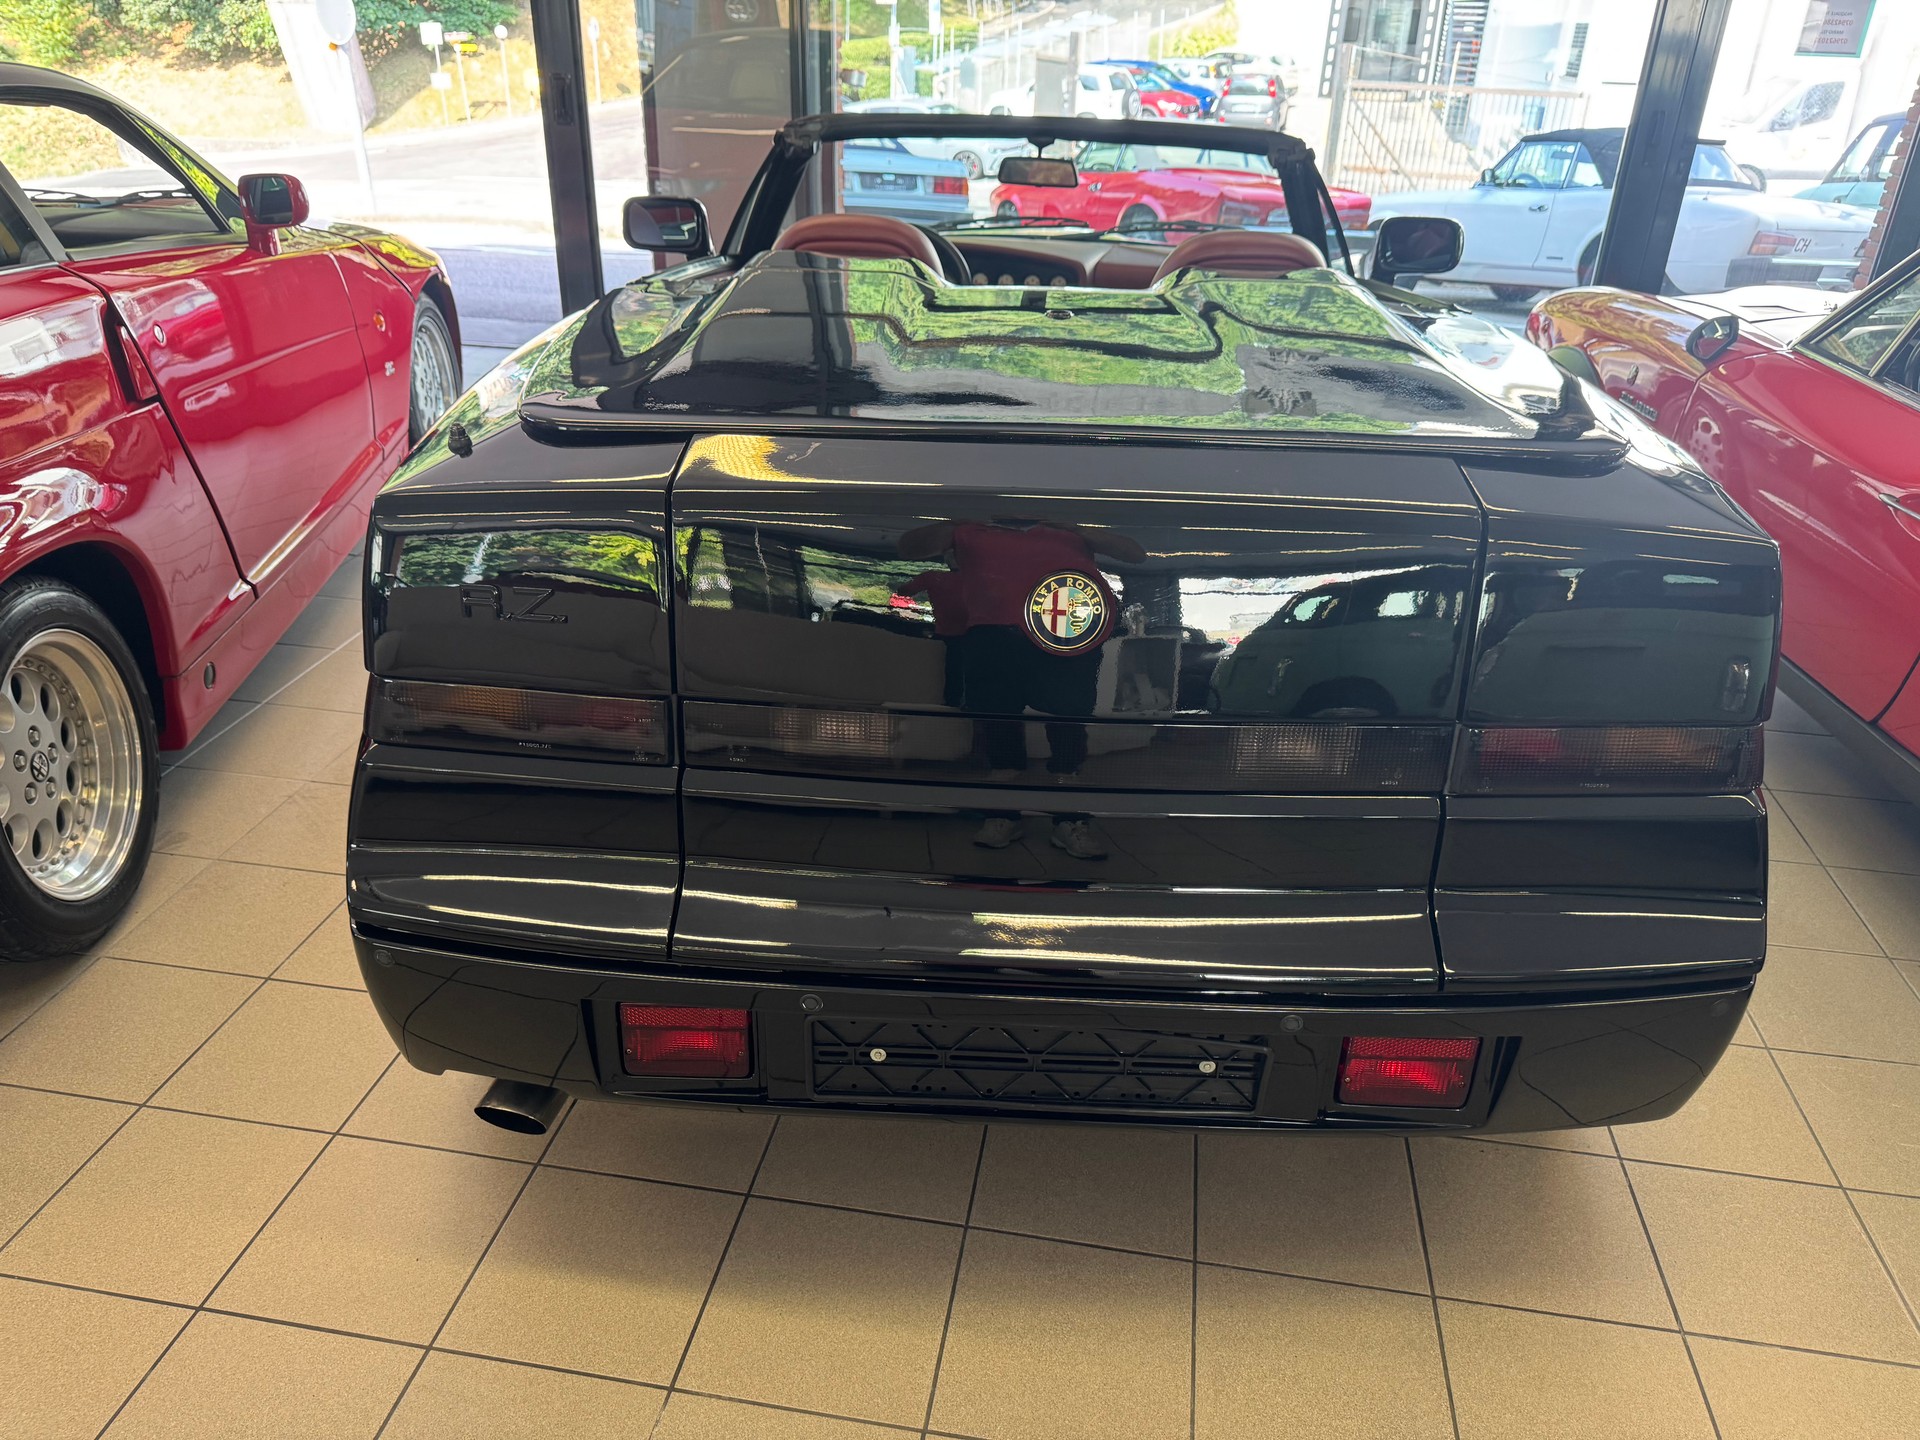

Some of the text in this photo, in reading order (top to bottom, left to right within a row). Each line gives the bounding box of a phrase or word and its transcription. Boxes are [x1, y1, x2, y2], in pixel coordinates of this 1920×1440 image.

[1794, 238, 1812, 253] CH
[460, 583, 568, 624] RZ
[1033, 577, 1102, 615] ALFA ROMEO
